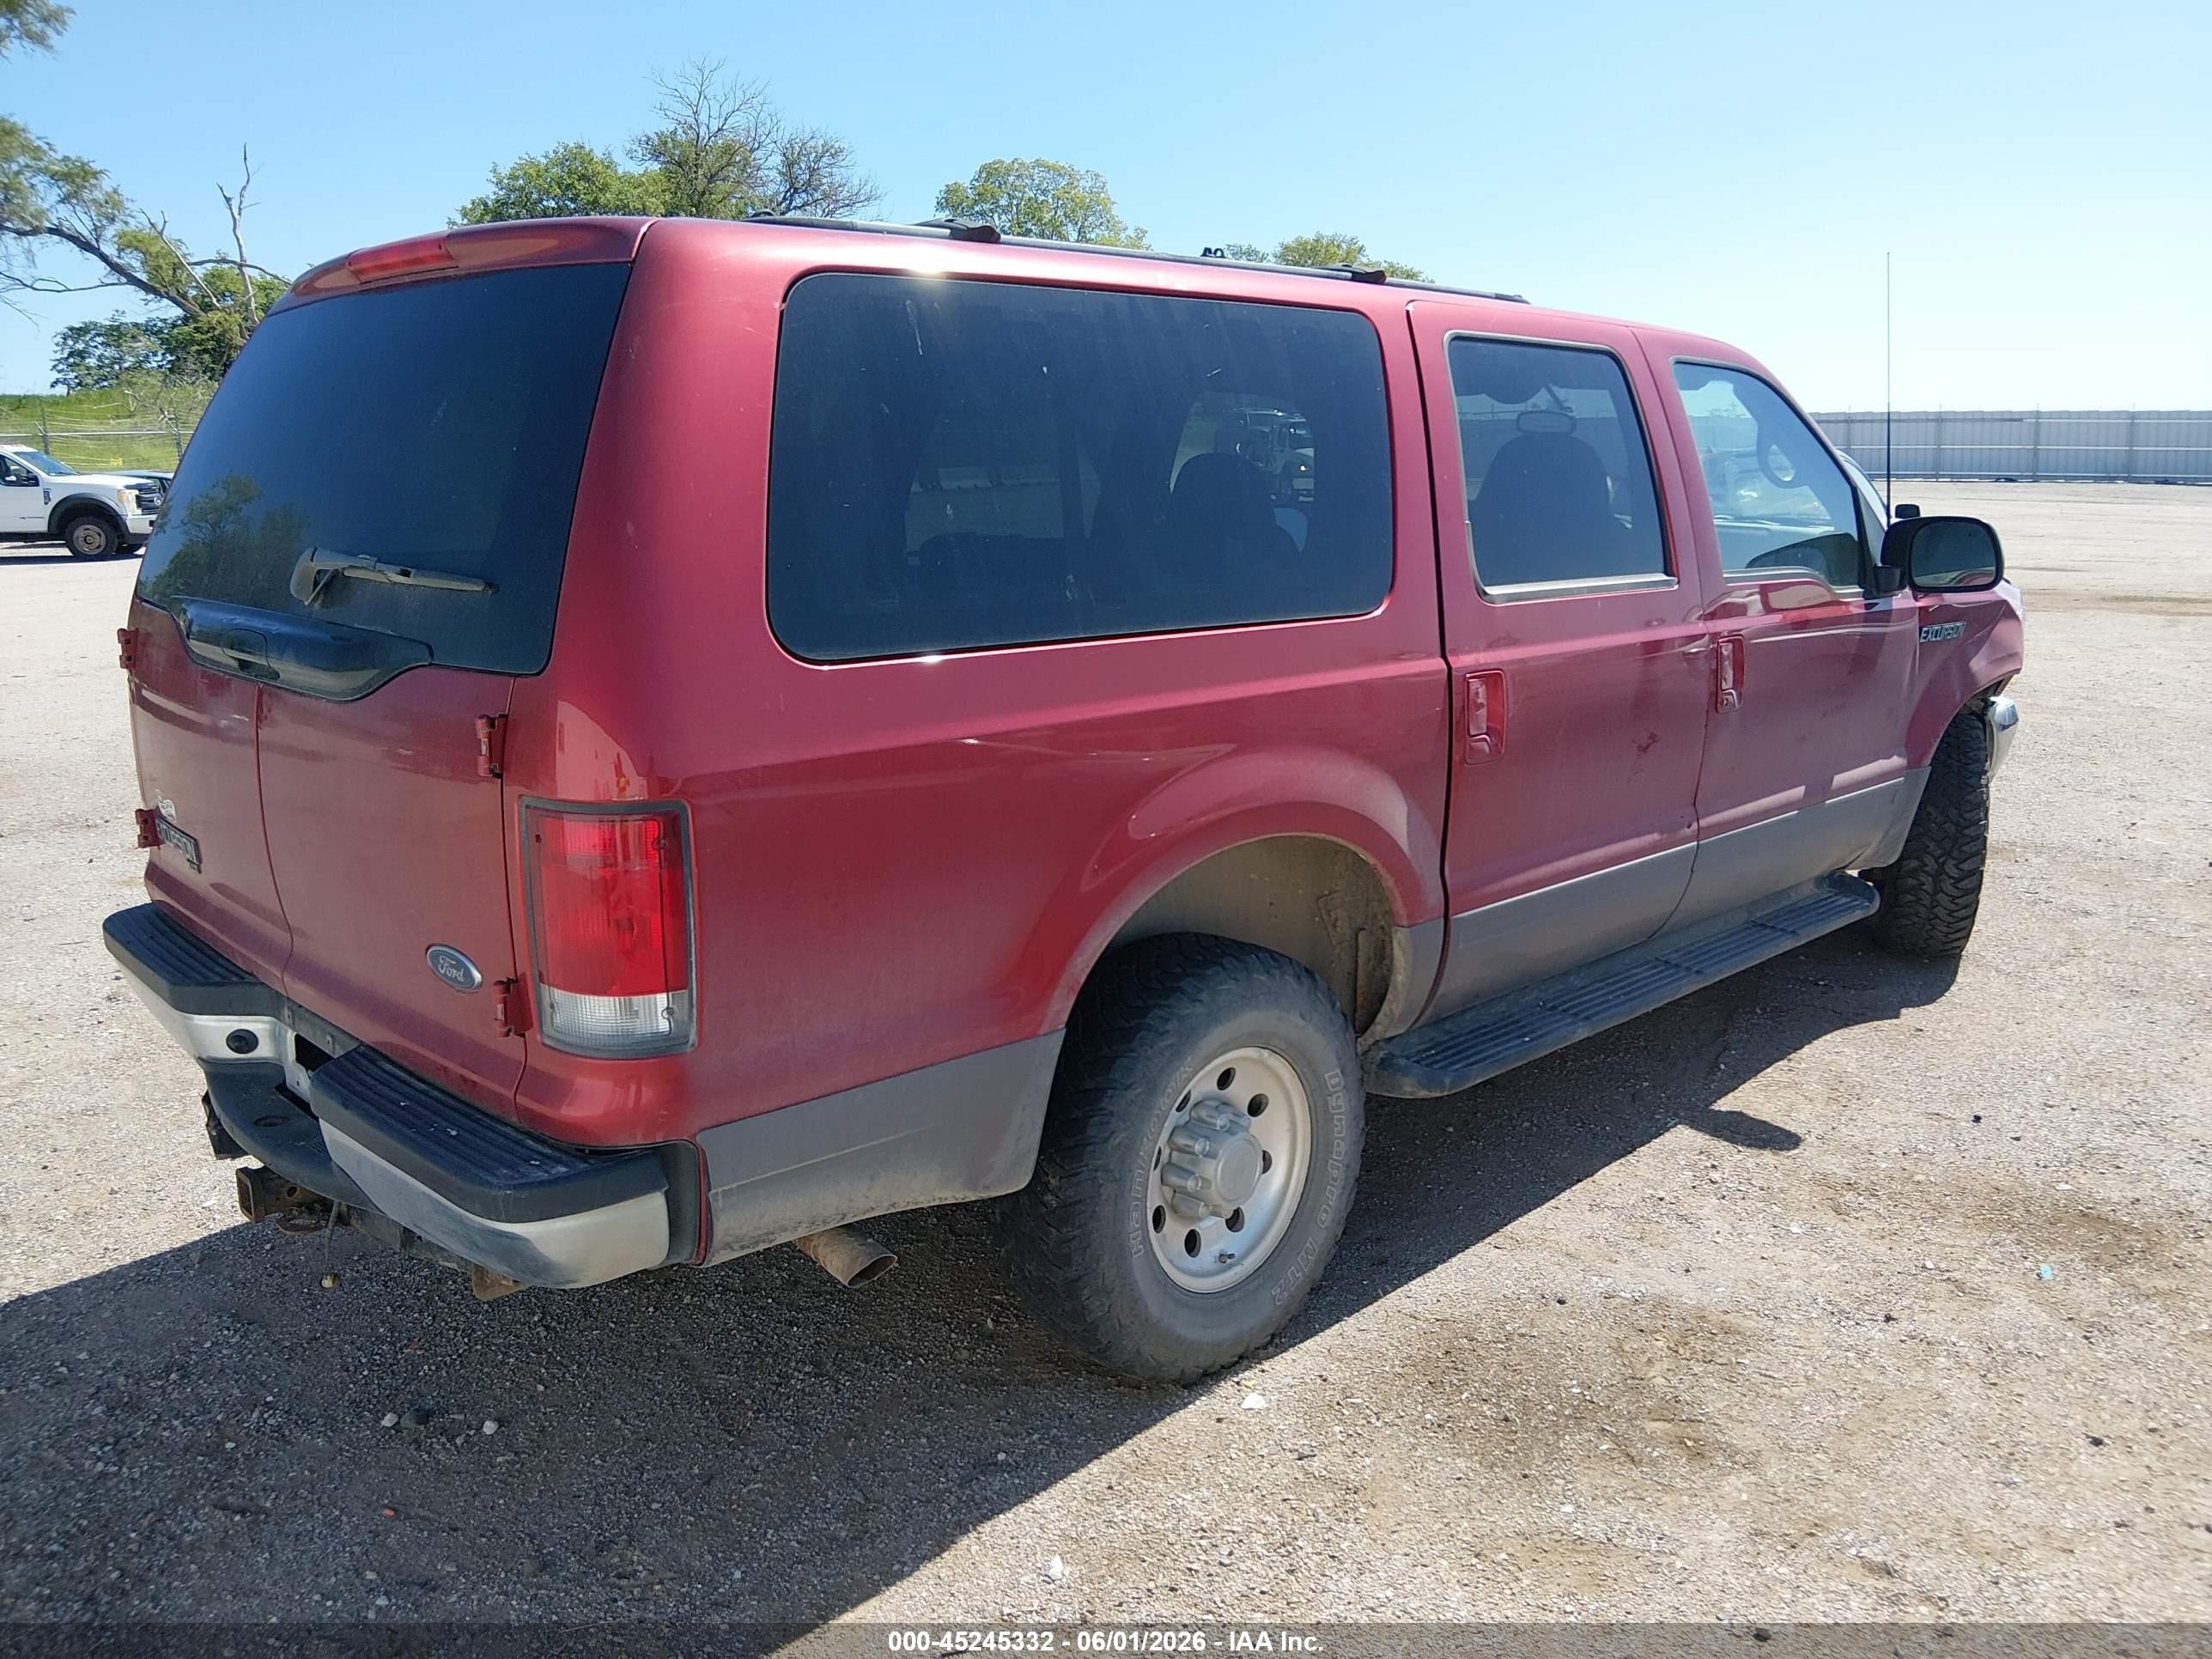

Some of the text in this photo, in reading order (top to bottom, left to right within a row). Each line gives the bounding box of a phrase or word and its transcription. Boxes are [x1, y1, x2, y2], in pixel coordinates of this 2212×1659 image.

[1920, 622, 1966, 642] EXCURSION
[437, 954, 465, 982] Ford
[1271, 1070, 1346, 1306] Dynapro MT2
